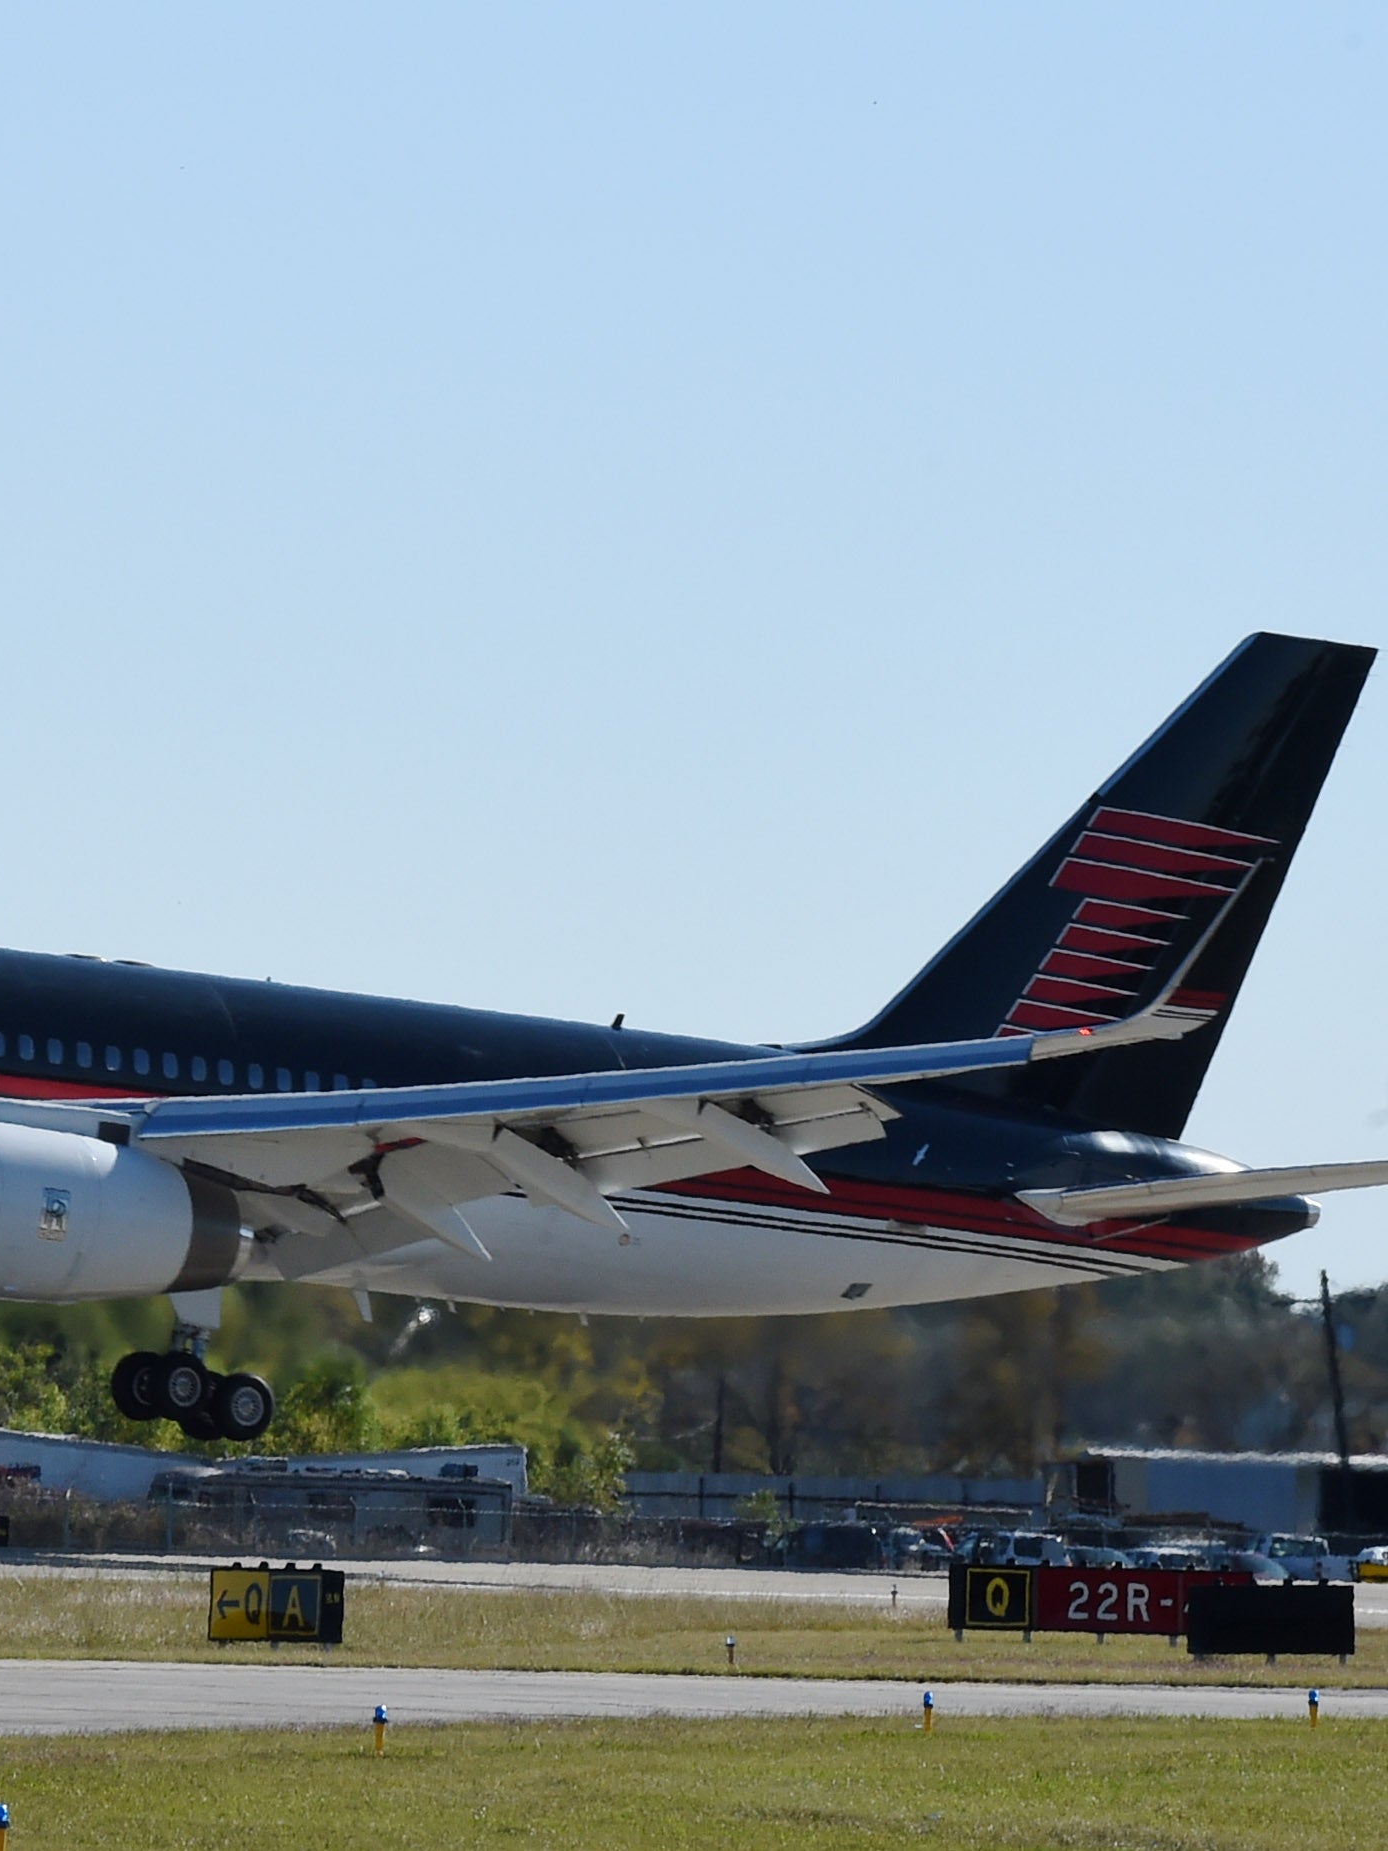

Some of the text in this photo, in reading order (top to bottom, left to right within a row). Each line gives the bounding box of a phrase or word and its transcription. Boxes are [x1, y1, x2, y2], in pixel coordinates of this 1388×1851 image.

[244, 1582, 305, 1628] Q A
[985, 1576, 1010, 1617] Q
[1067, 1581, 1189, 1621] 22R-
